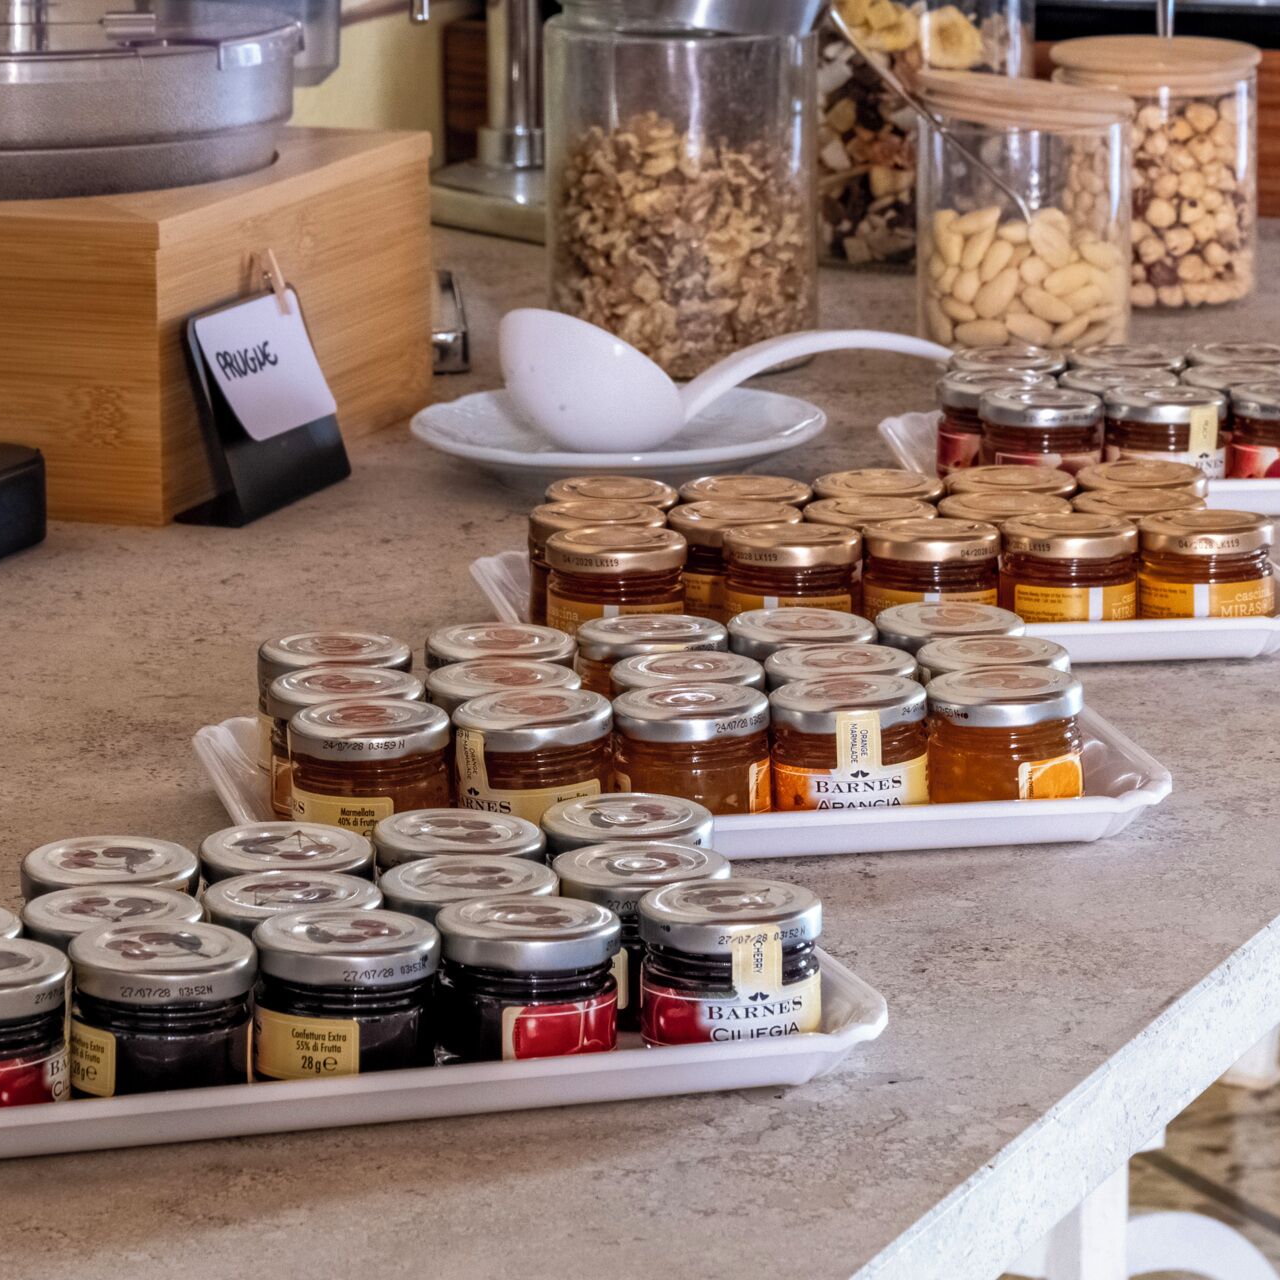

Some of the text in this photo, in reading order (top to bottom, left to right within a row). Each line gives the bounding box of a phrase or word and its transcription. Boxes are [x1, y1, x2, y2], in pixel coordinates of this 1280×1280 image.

[595, 558, 619, 568] LK119
[754, 551, 778, 562] LK119
[550, 607, 579, 621] ascina
[322, 740, 364, 752] 24/07/28
[368, 740, 397, 751] 03:59
[850, 723, 859, 764] MARMALADE
[860, 729, 869, 757] ORANGE
[815, 776, 902, 794] BARNES
[340, 807, 375, 817] Marmellata
[460, 796, 511, 814] ARNES
[338, 817, 351, 826] 40%
[352, 817, 359, 826] di
[717, 933, 768, 946] 27/07/28
[752, 939, 763, 975] CHERRY
[342, 968, 394, 983] 27/07/28
[120, 986, 171, 998] 27/07/28
[707, 995, 803, 1021] BARNES
[291, 1028, 347, 1042] Confettura Extra
[90, 1041, 105, 1054] Extra
[296, 1040, 341, 1054] 55% di Frutta
[85, 1051, 101, 1064] Frutta
